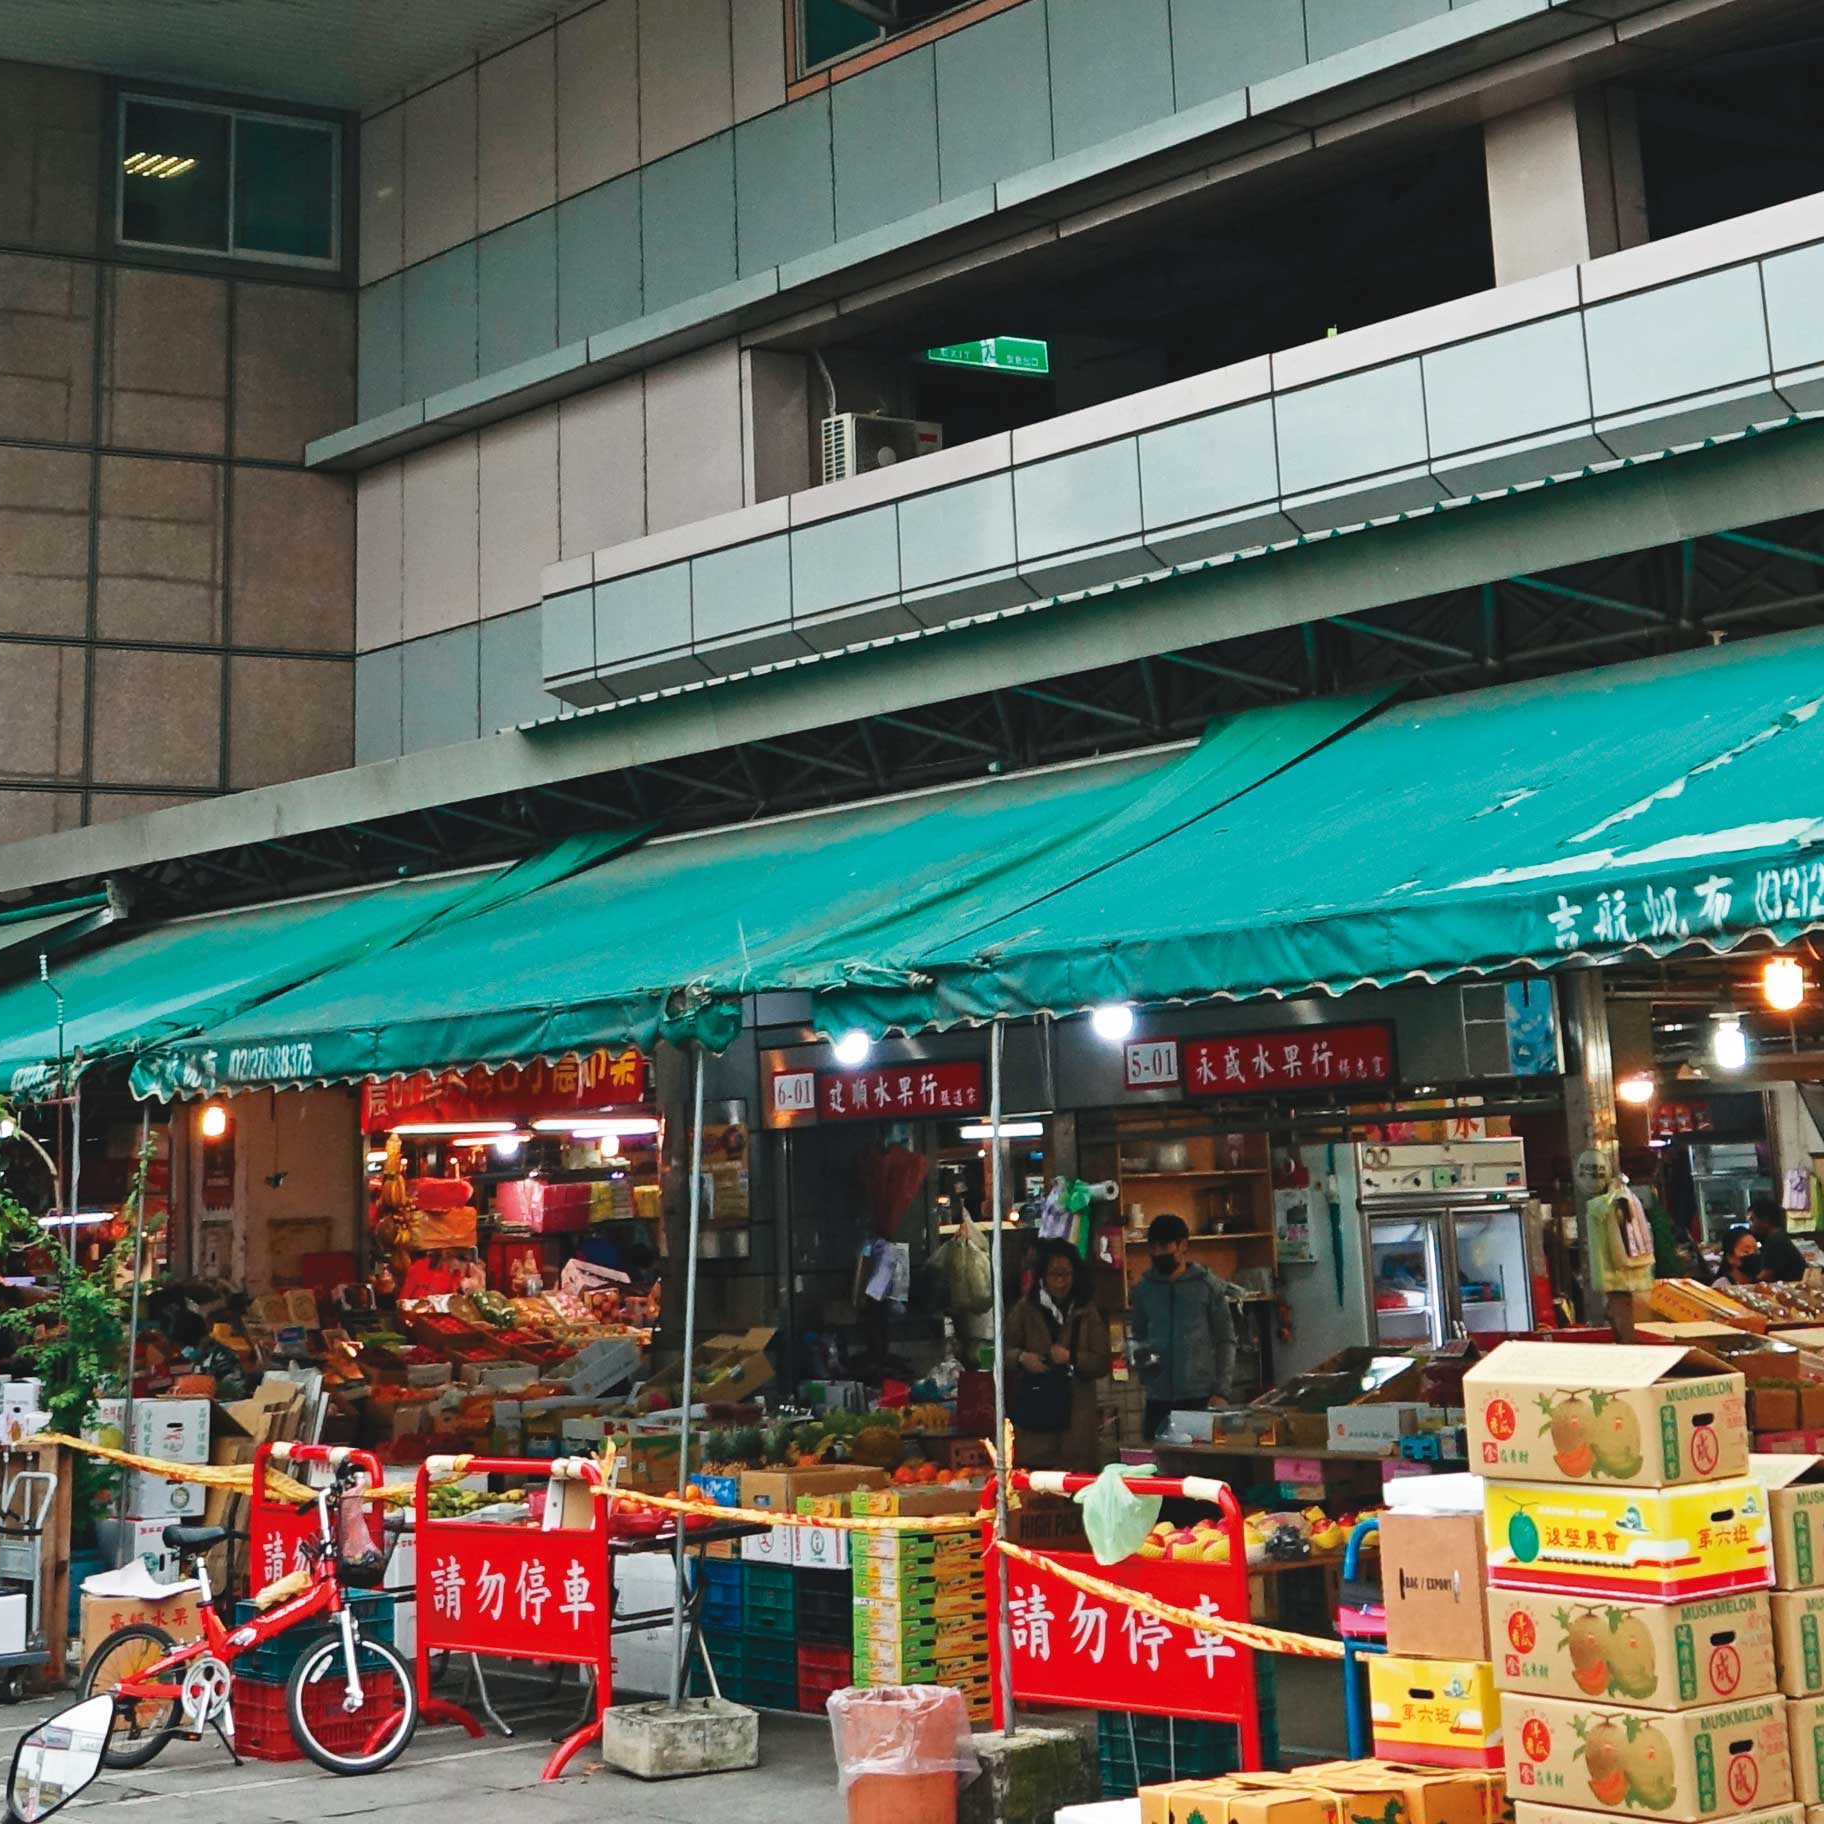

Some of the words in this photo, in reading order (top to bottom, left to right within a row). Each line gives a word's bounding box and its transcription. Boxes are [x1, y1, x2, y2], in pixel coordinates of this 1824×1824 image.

[939, 348, 971, 359] EXIT
[1132, 1047, 1175, 1078] 5-01
[778, 1079, 812, 1105] 6-01
[1665, 1380, 1733, 1402] MUSKMELON
[431, 1555, 595, 1632] 請勿停車
[1680, 1596, 1757, 1621] MUSKMELON
[1009, 1583, 1236, 1679] 請勿停車
[1700, 1703, 1774, 1729] MUSKMELON
